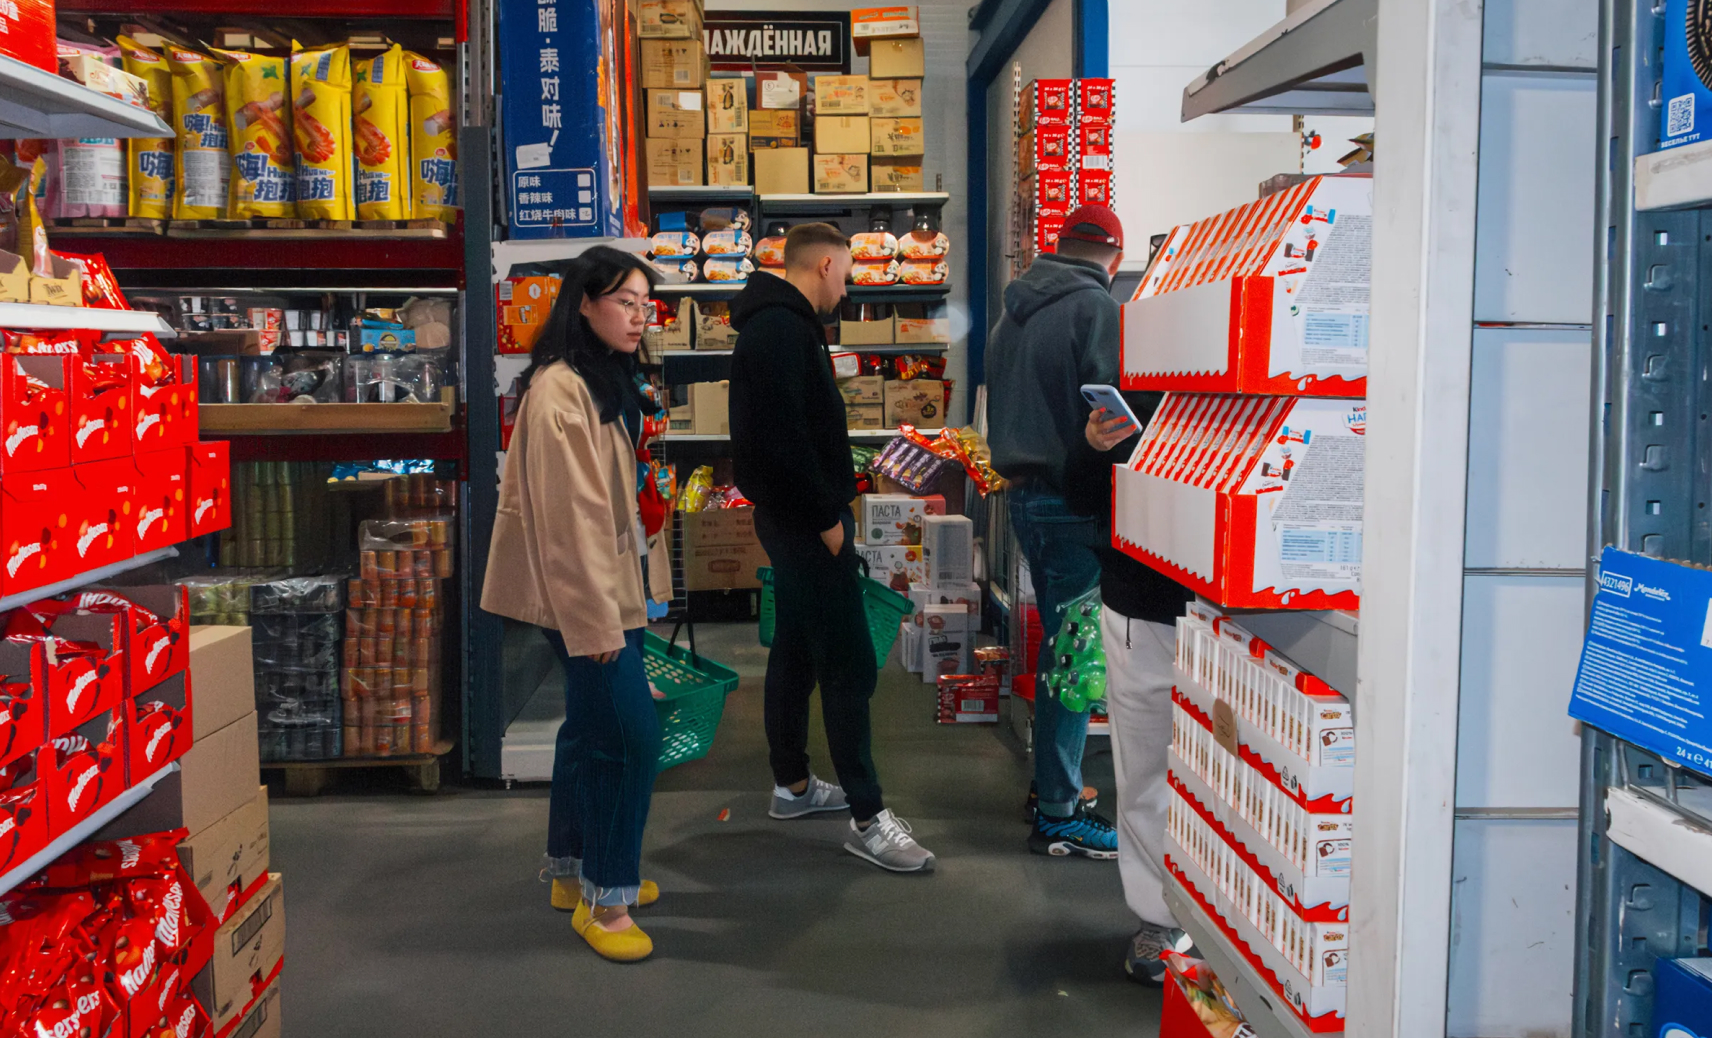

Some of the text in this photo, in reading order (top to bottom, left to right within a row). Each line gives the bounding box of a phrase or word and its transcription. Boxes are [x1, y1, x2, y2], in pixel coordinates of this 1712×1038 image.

[43, 283, 64, 296] Twix
[872, 504, 901, 518] ПАСТА
[1676, 745, 1686, 757] 24
